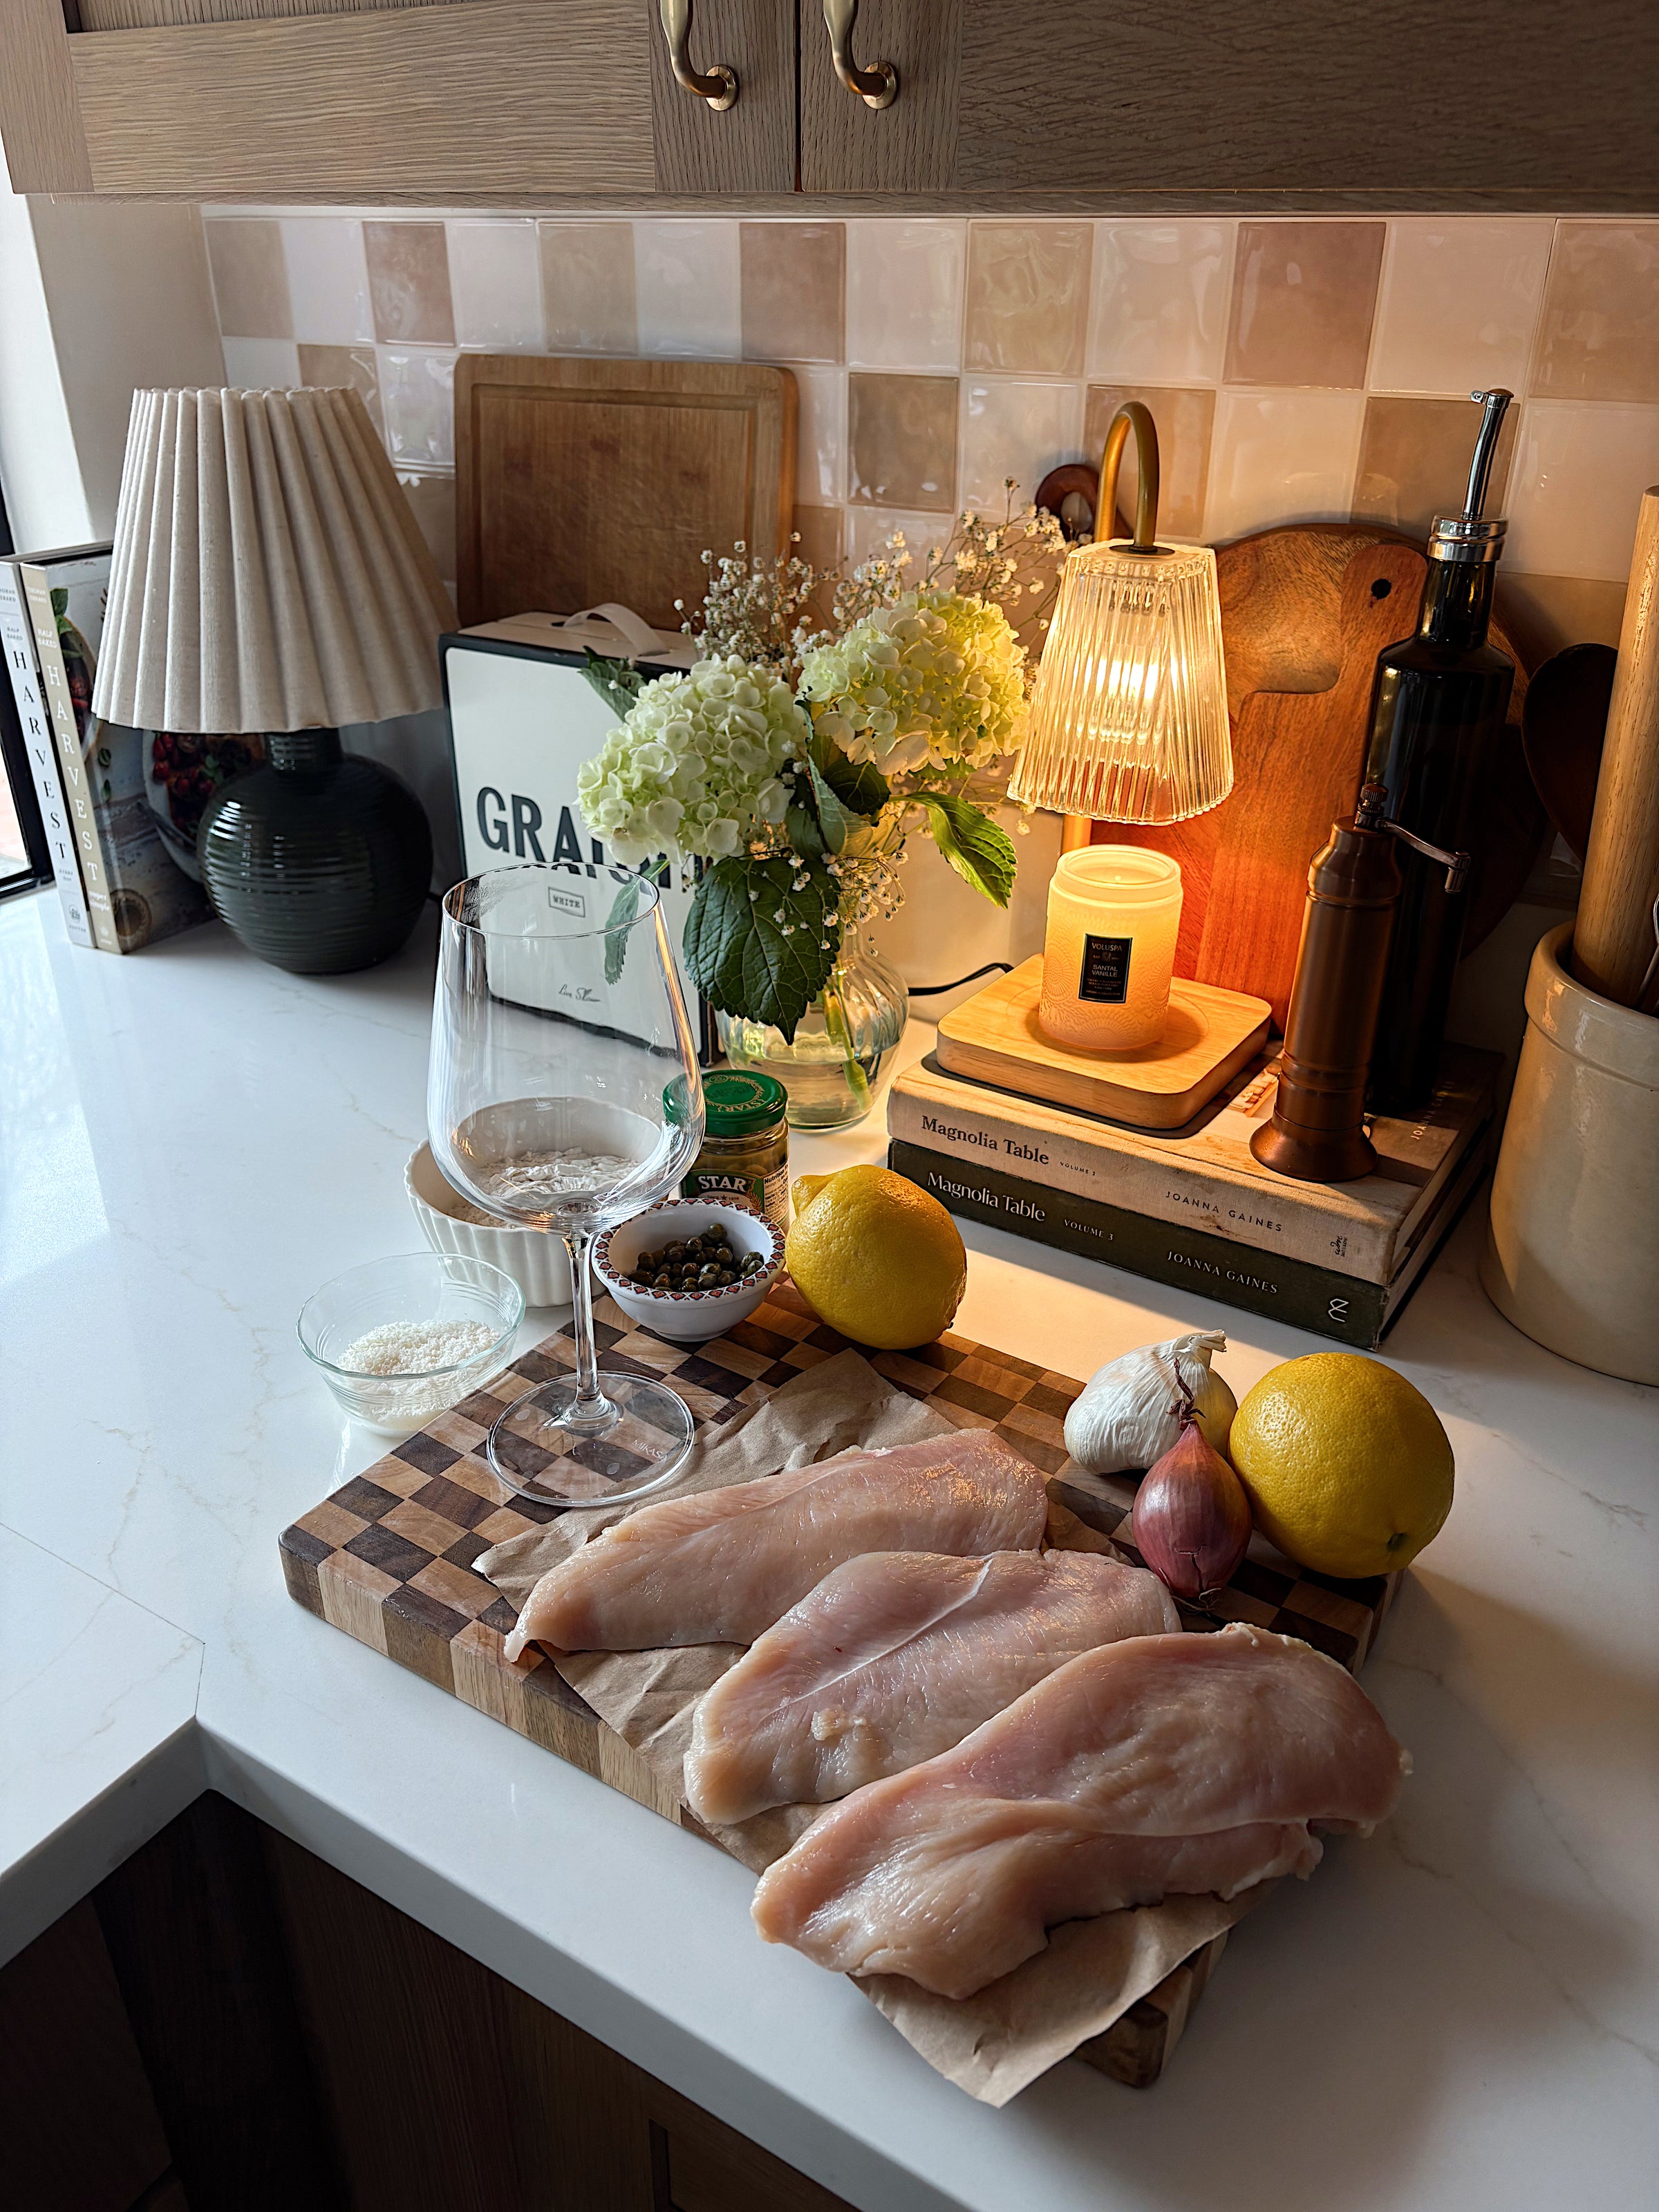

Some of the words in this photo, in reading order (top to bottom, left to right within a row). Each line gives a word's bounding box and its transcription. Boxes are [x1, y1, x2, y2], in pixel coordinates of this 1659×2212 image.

[13, 650, 66, 859] HARVEST
[46, 665, 97, 881] HARVEST
[552, 894, 581, 908] WHITE
[1091, 942, 1123, 951] VOLUSPA
[1093, 964, 1118, 972] SANTAL
[724, 1099, 761, 1112] STAR
[921, 1115, 998, 1150] Magnolia
[1003, 1138, 1049, 1165] Table
[1060, 1161, 1089, 1174] VOLUME
[697, 1175, 747, 1192] STAR
[927, 1172, 999, 1208] Magnolia
[1002, 1194, 1046, 1221] Table
[1063, 1219, 1105, 1238] VOLUME
[1165, 1191, 1219, 1213] JOANNA
[1228, 1210, 1282, 1232] GAINES
[1168, 1250, 1220, 1276] JOANNA
[1226, 1271, 1278, 1294] GAINES
[631, 1439, 668, 1462] MIKASA
